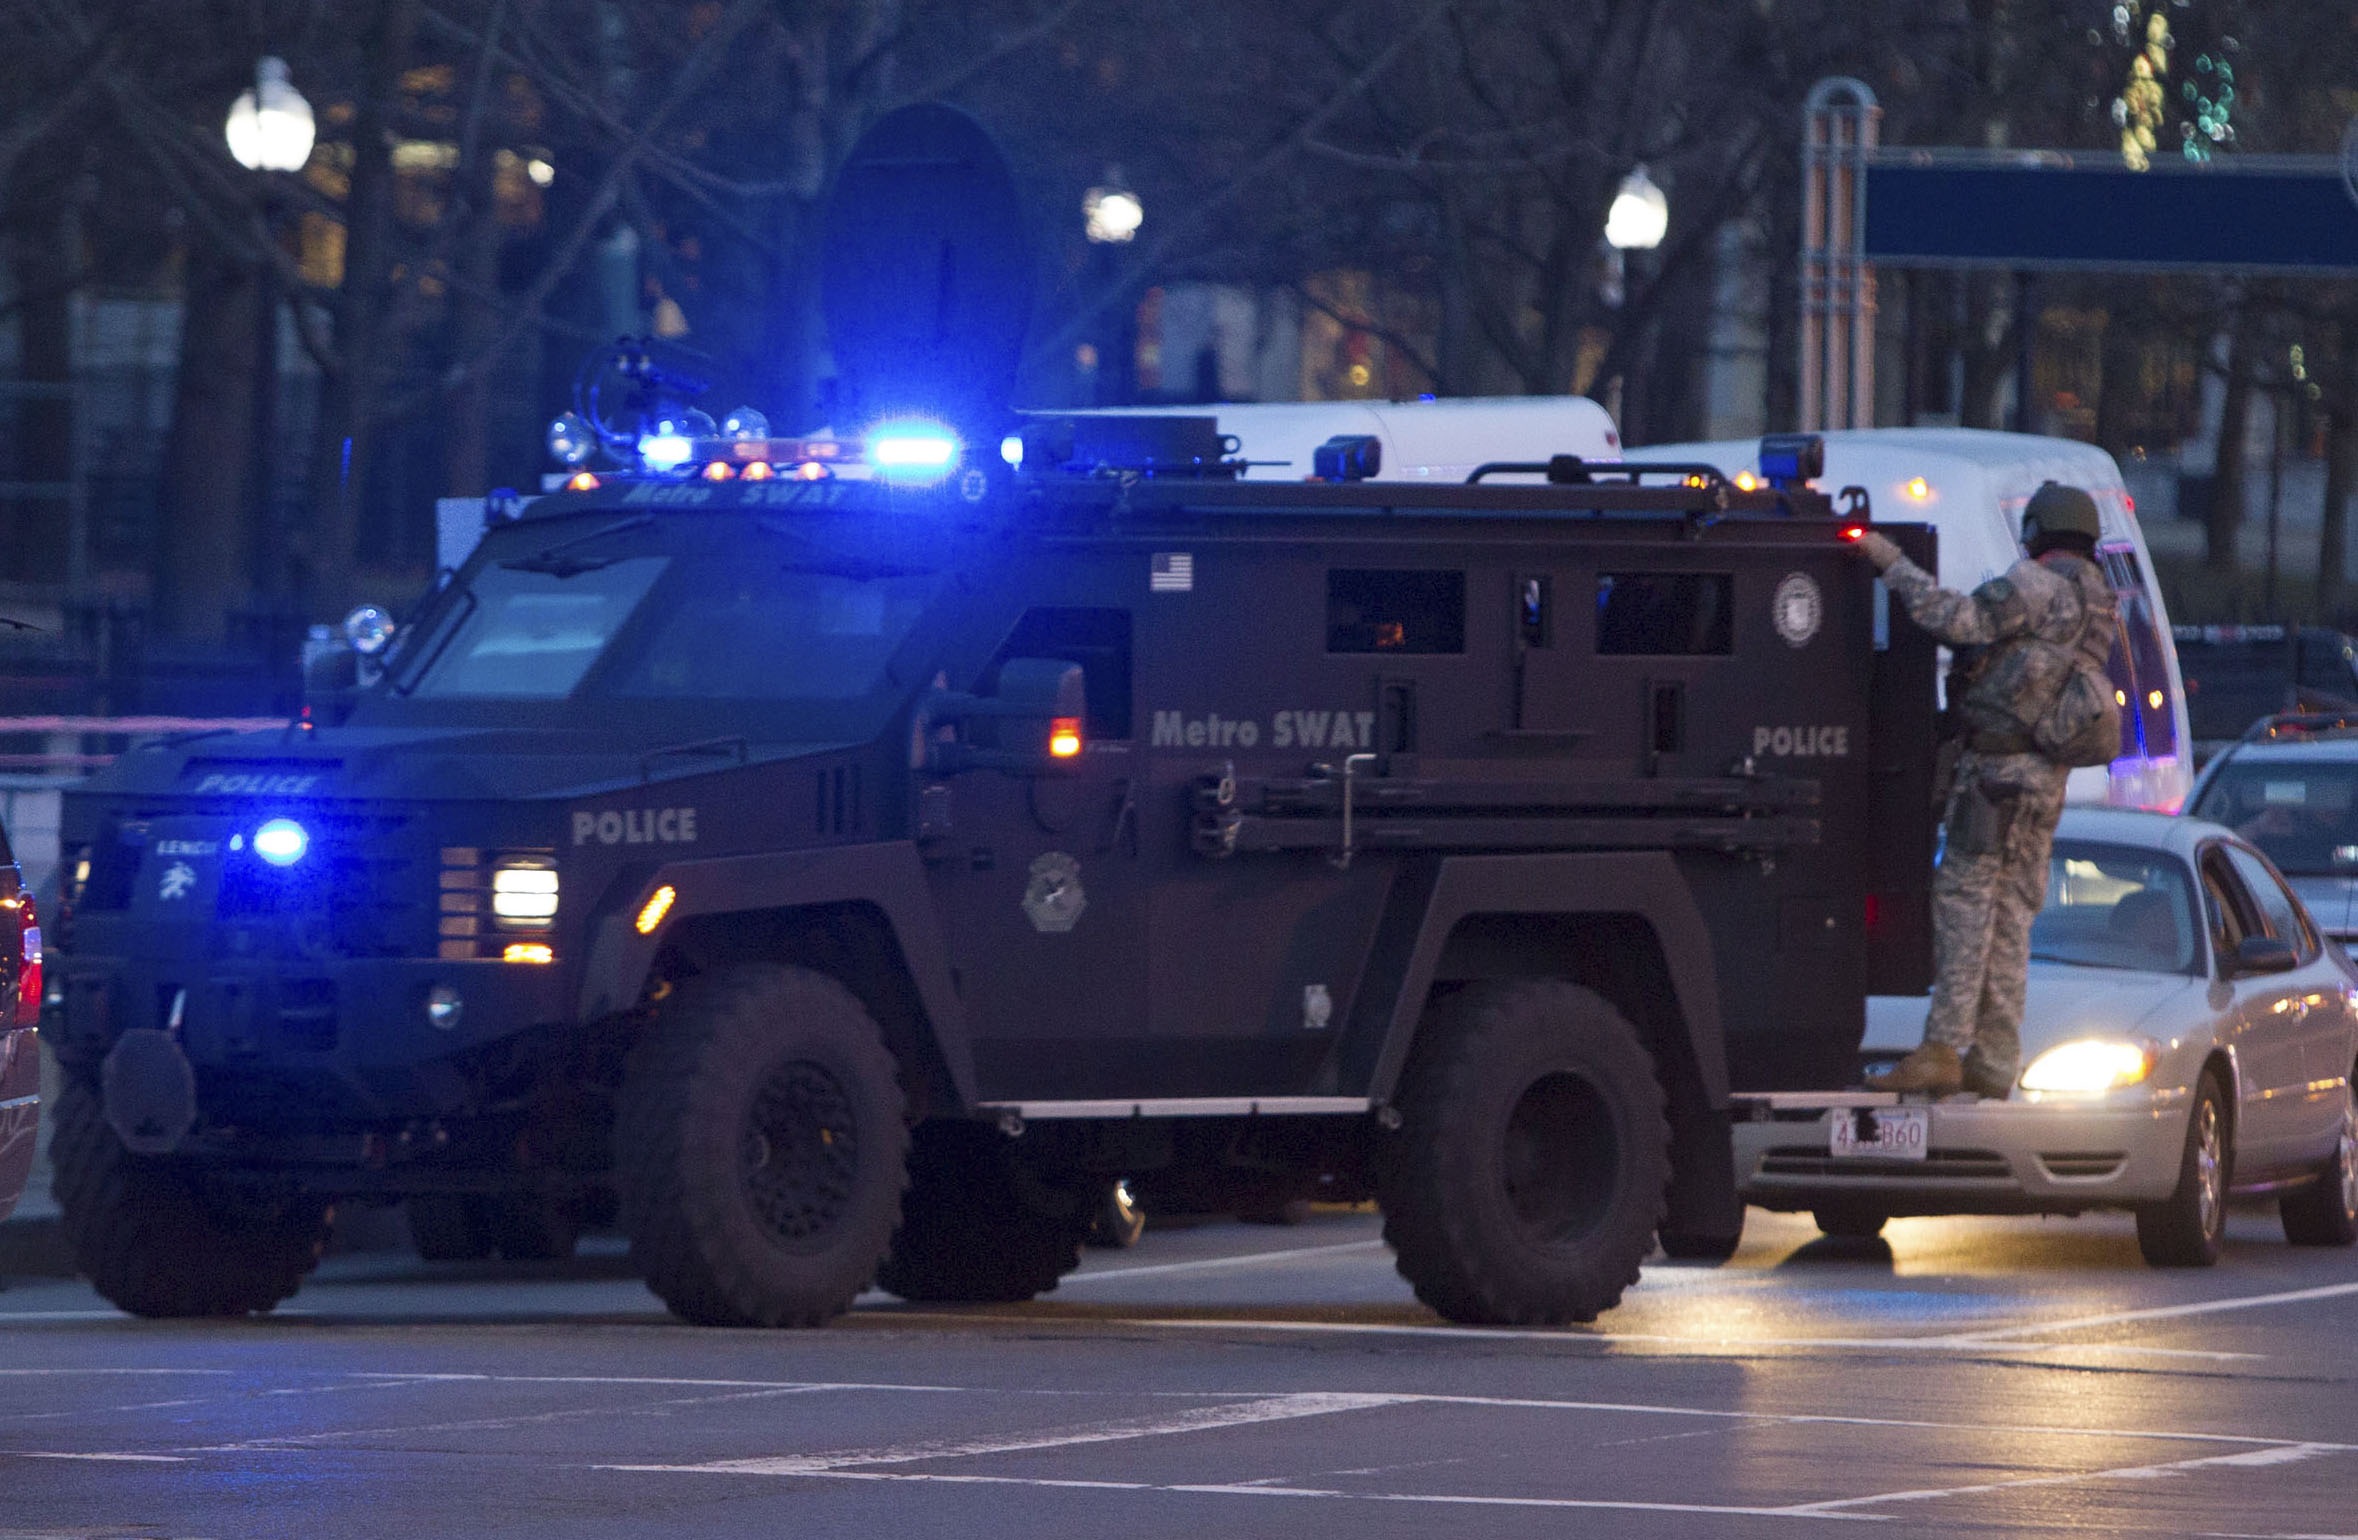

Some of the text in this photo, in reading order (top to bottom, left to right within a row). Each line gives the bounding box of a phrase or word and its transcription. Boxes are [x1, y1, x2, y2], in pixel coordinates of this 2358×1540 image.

[621, 481, 847, 504] Metro SWAT
[1152, 710, 1375, 747] Metro SWAT
[1754, 726, 1848, 756] POLICE
[194, 774, 317, 793] POLICE
[572, 808, 697, 846] POLICE
